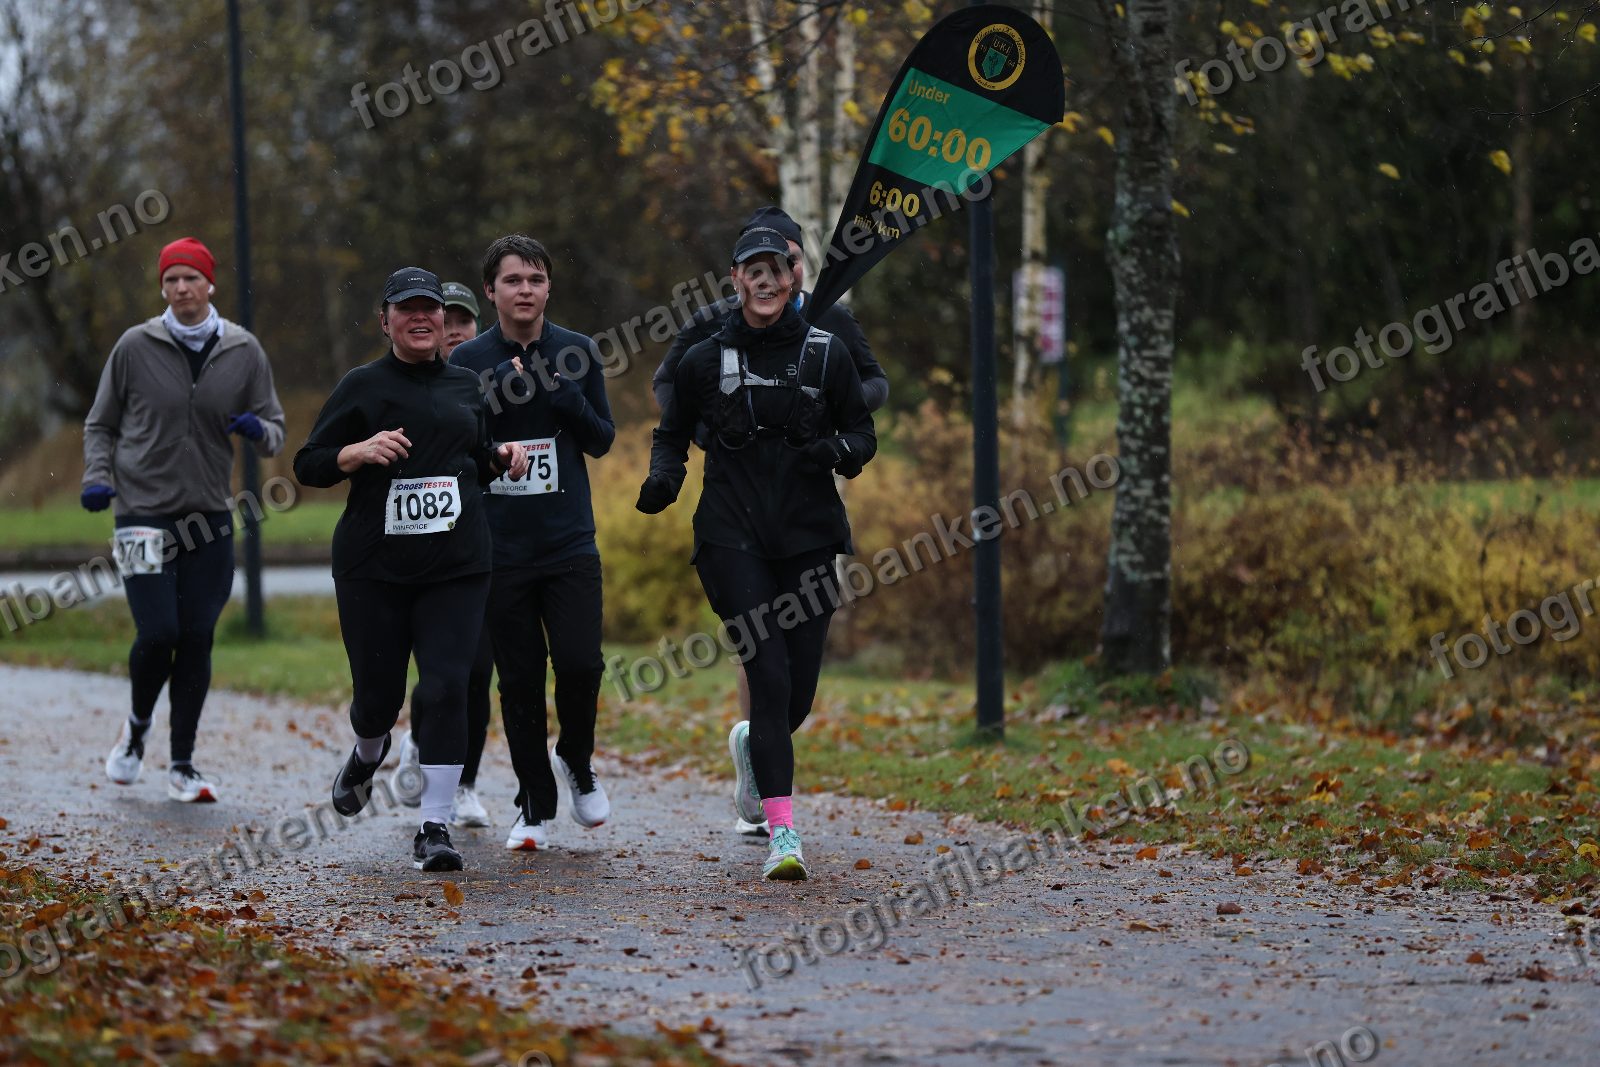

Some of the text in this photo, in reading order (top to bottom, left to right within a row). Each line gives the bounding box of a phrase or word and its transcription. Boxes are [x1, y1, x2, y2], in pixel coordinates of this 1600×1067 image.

[908, 80, 950, 104] Under
[888, 107, 992, 172] 60:00
[869, 180, 920, 217] 6:00
[854, 213, 900, 239] min/km
[394, 491, 455, 521] 1082
